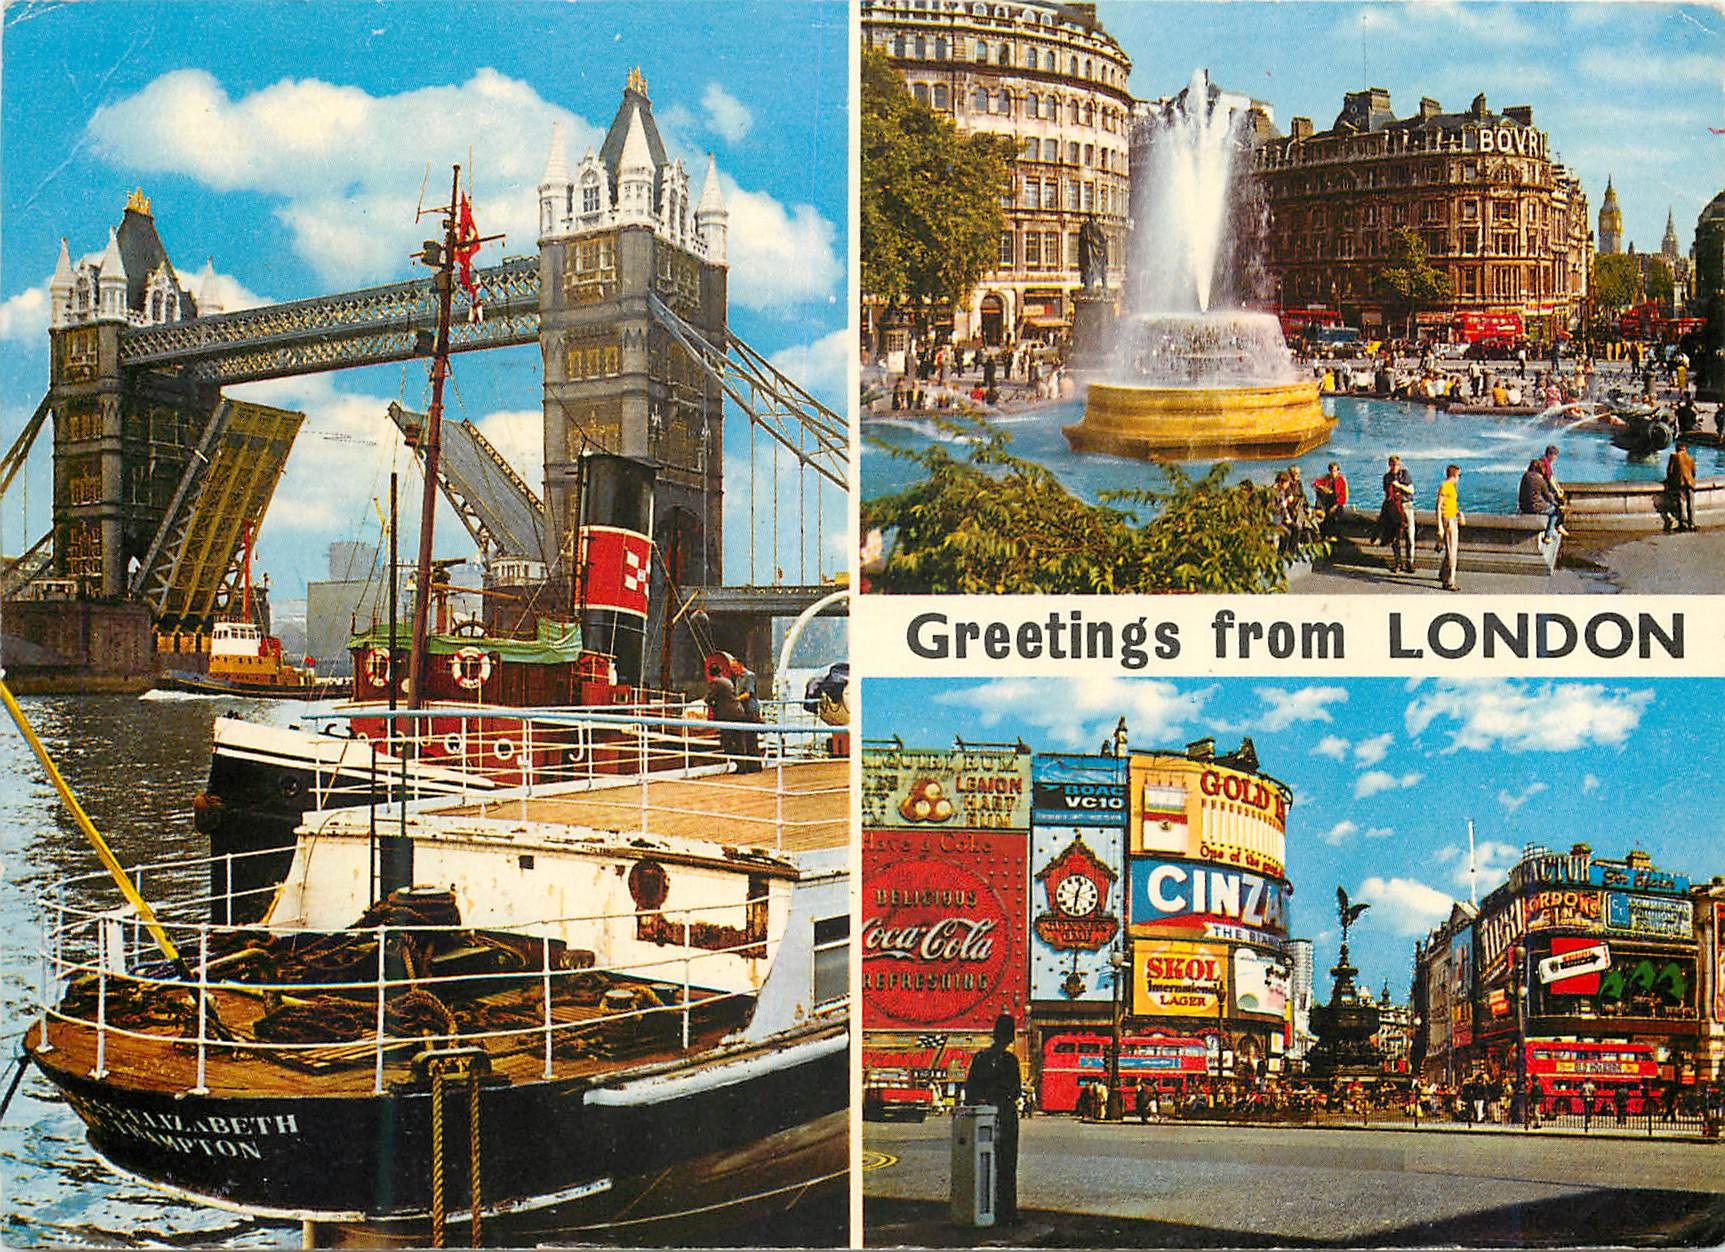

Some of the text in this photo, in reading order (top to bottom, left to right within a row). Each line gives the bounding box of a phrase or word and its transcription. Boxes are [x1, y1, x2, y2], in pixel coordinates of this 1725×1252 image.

[956, 775, 1023, 794] LEMON
[1064, 785, 1124, 796] BOAC
[1200, 770, 1270, 809] GOLD
[963, 794, 1016, 811] HART
[1065, 796, 1125, 808] VC10
[966, 811, 1012, 828] RUM
[1200, 845, 1224, 858] One
[876, 889, 977, 909] DELICIOUS
[1541, 907, 1573, 921] GIN
[862, 917, 999, 962] Coca-Cola
[1213, 925, 1243, 940] THE
[1147, 957, 1220, 982] SKOL
[862, 972, 988, 991] REFRESHING
[1147, 979, 1220, 994] International
[1160, 995, 1206, 1007] LAGER
